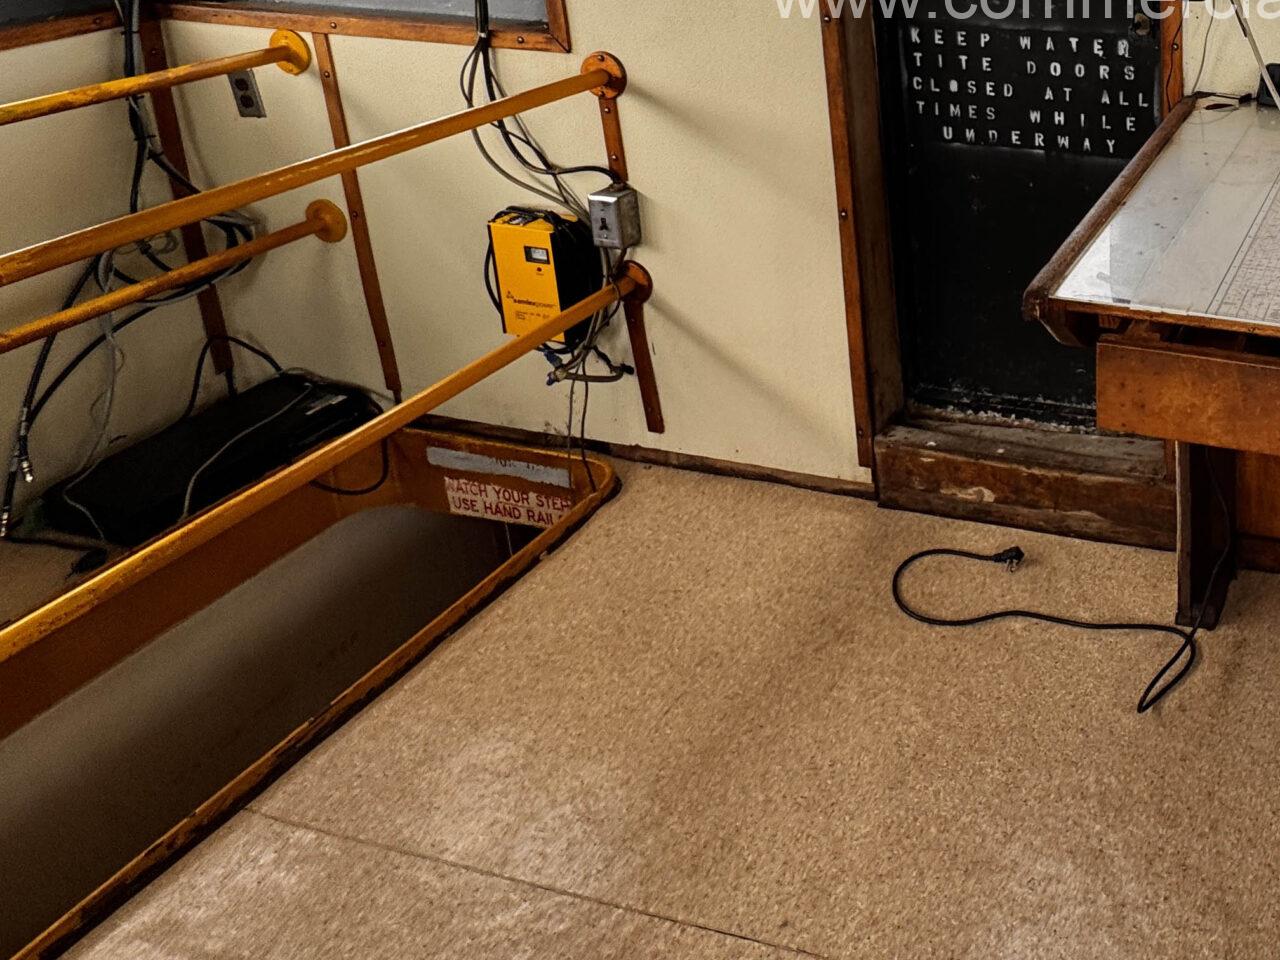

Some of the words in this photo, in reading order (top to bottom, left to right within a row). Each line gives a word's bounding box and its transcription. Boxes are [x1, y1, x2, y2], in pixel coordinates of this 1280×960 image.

[910, 27, 991, 48] KEEP
[1019, 35, 1130, 58] WATER
[912, 52, 992, 72] TITE
[1026, 60, 1135, 81] DOORS
[912, 76, 1014, 97] CLOSED
[1044, 86, 1072, 101] AT
[1101, 92, 1149, 108] ALL
[915, 100, 996, 120] TIMES
[1029, 109, 1136, 132] WHILE
[942, 126, 1116, 154] UNDERWAY
[452, 496, 479, 513] USE
[484, 501, 521, 520] HAND
[492, 486, 530, 505] YOUR
[535, 494, 571, 511] STEP
